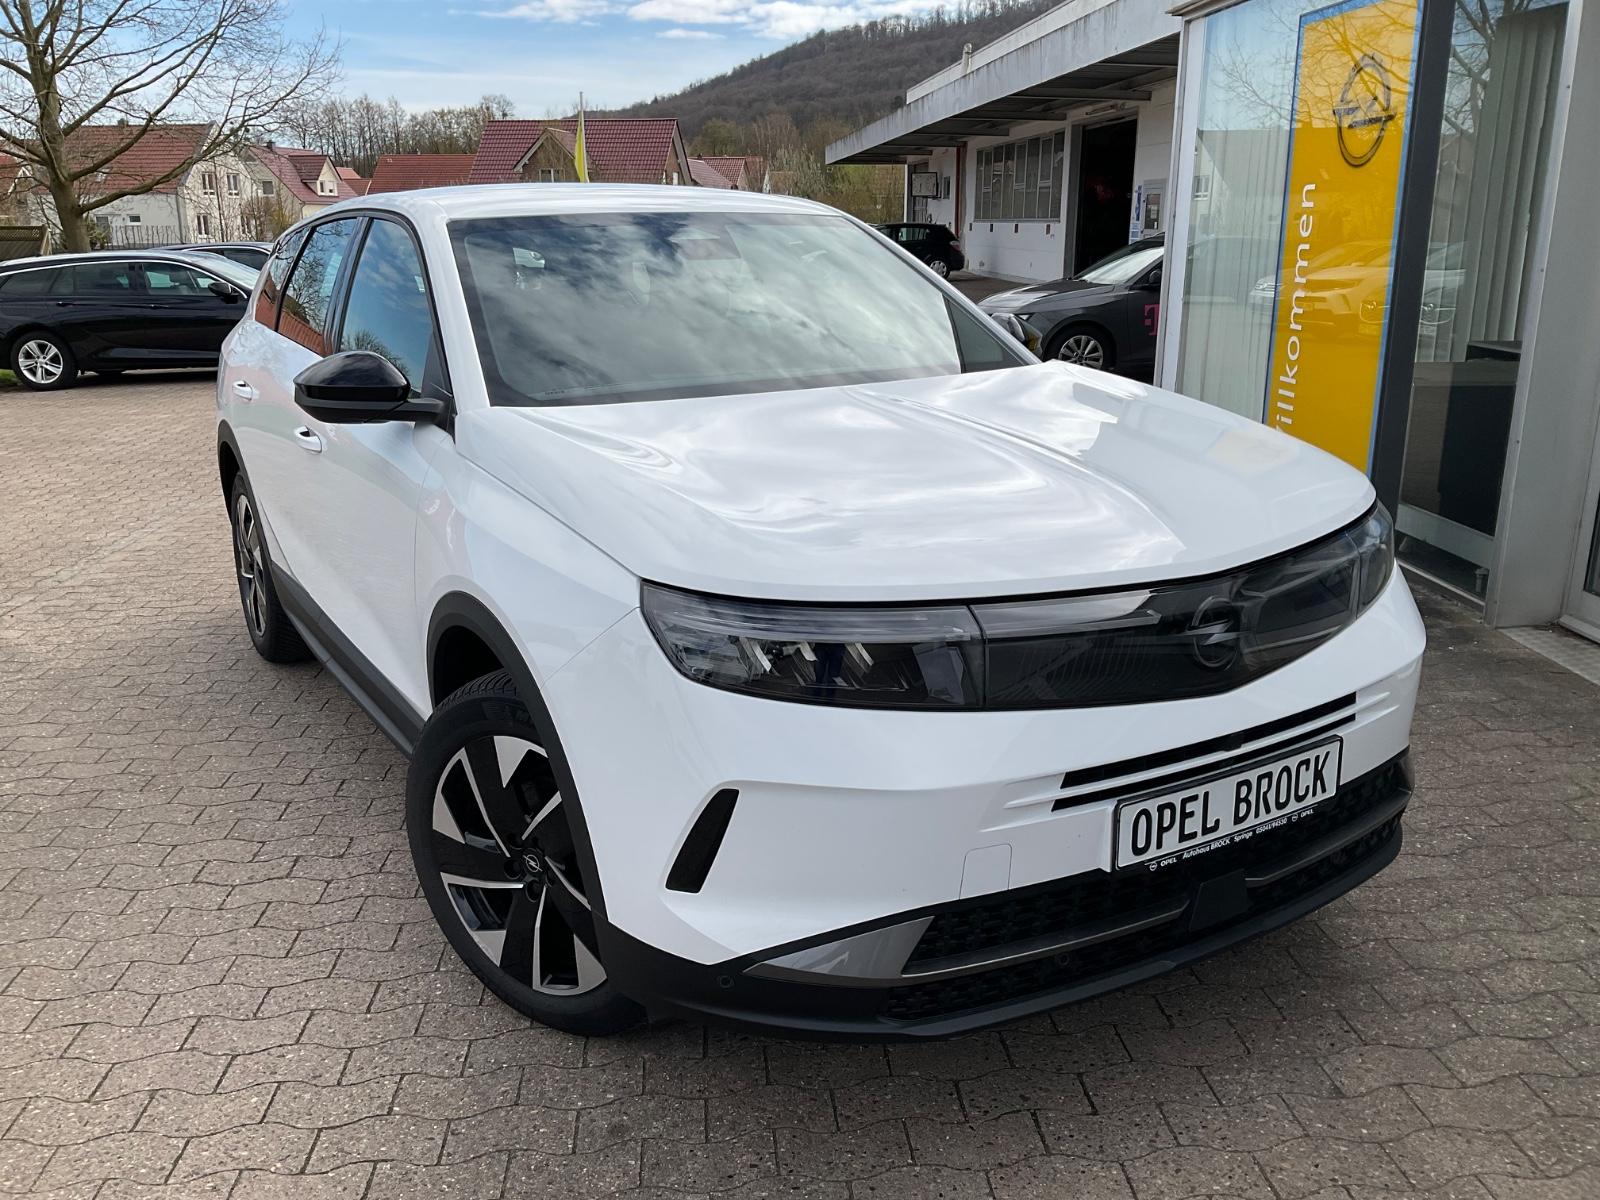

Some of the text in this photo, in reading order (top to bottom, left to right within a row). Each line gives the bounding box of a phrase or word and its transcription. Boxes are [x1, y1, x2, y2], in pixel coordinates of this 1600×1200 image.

[1276, 183, 1316, 430] illkommen
[1131, 751, 1330, 856] OPEL BROCK
[1160, 857, 1177, 867] OPEL
[1183, 846, 1210, 859] Autohaus
[1210, 838, 1231, 850] BROCK
[1234, 831, 1253, 842] Springe
[1300, 809, 1314, 818] OPEL
